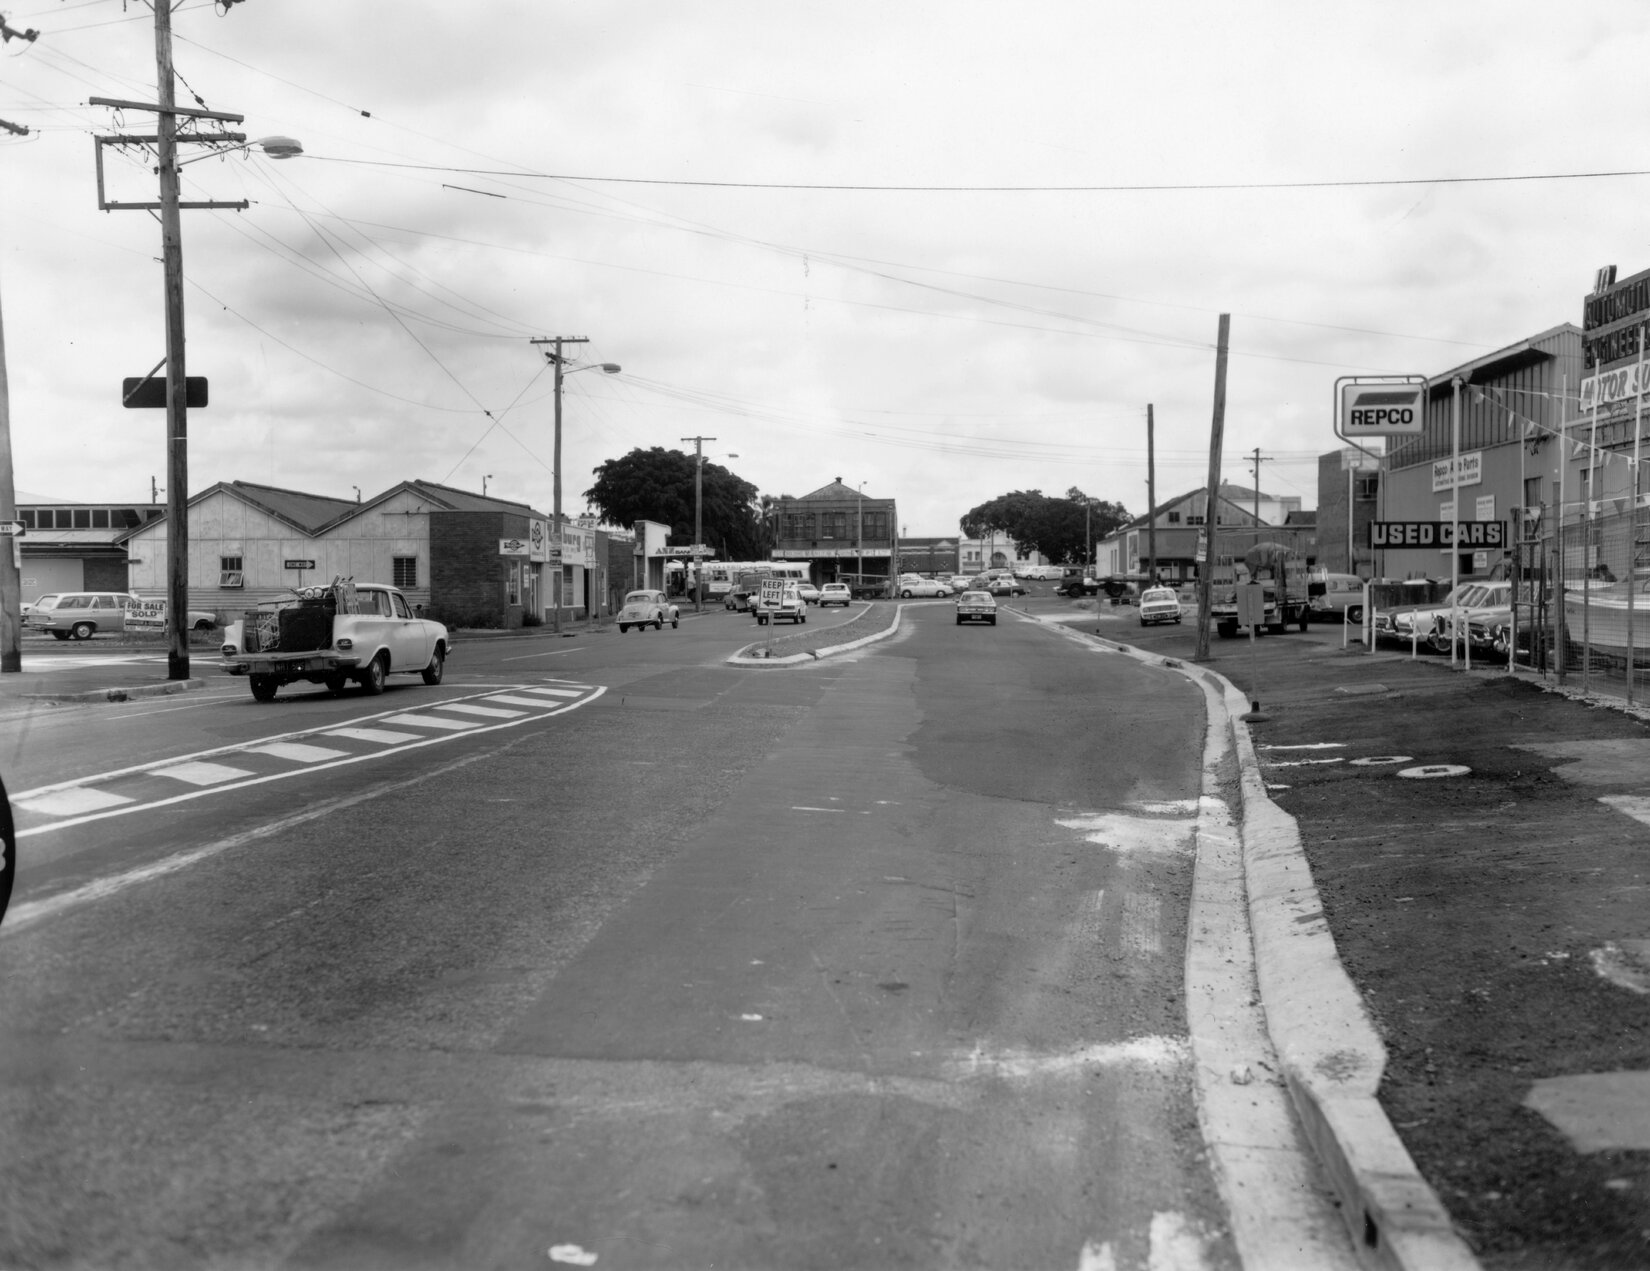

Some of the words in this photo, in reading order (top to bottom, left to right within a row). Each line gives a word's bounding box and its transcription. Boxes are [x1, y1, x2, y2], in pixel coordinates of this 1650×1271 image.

[1351, 408, 1413, 425] REPCO
[1463, 456, 1479, 471] Parts
[1373, 524, 1433, 544] USED
[1440, 523, 1500, 544] CARS
[655, 547, 675, 555] ANZ
[763, 581, 782, 589] KEEP
[763, 590, 780, 599] LEFT
[127, 602, 142, 610] FOR
[144, 603, 164, 611] SALE
